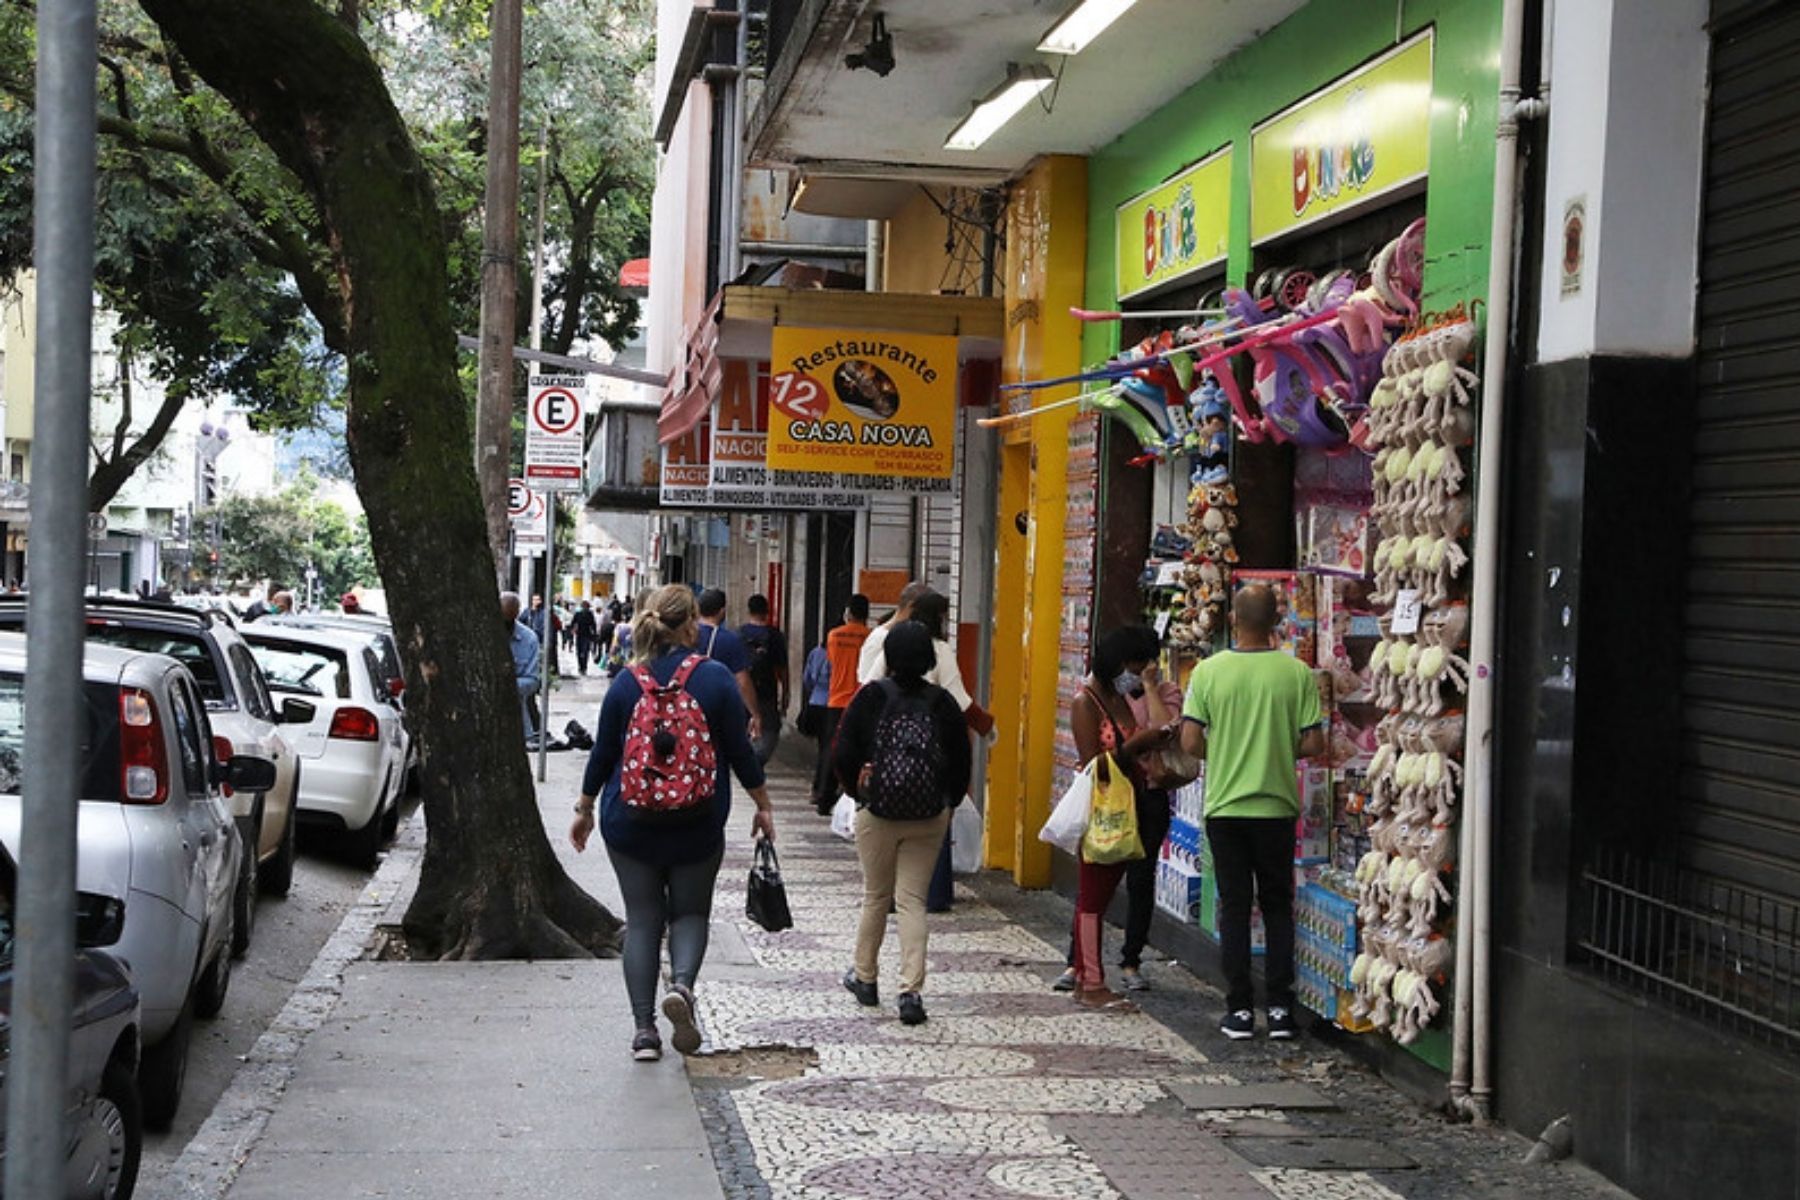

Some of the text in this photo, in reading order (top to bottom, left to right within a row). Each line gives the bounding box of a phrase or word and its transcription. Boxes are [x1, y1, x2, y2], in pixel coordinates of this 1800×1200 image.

[792, 339, 938, 385] Restaurante
[774, 373, 818, 416] 12
[548, 396, 565, 425] E
[788, 419, 933, 448] CASA NOVA
[777, 443, 848, 457] SELF-SERVICE
[877, 449, 944, 461] CHURRASCO
[714, 467, 766, 486] ALIMENTOS
[663, 488, 865, 507] ALIMENTOS BRINQUEDOS UTILIDADES PAPELARIA
